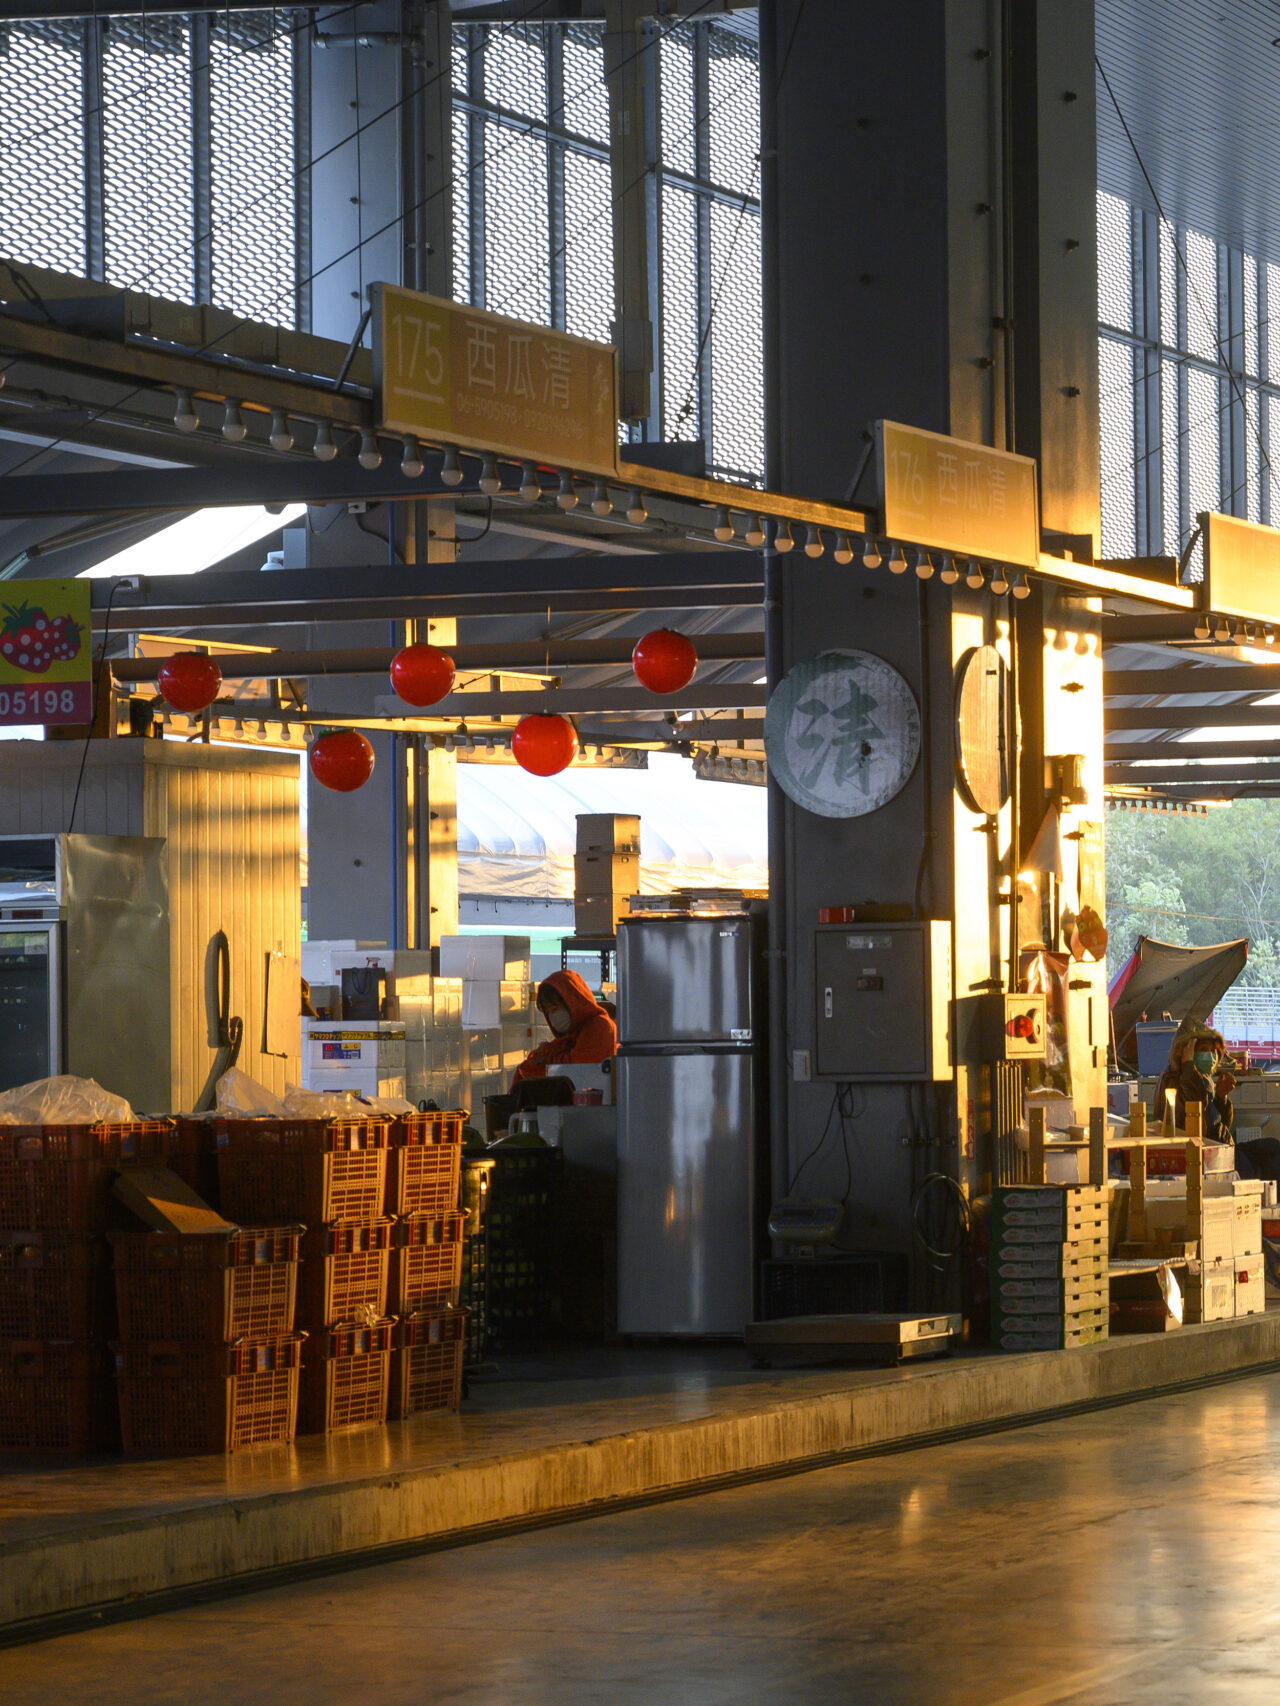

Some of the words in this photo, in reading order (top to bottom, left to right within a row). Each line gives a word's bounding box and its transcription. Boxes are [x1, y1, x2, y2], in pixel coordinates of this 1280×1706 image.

[391, 313, 444, 385] 175
[464, 320, 573, 410] 西瓜清
[890, 448, 925, 505] 176
[936, 451, 1008, 519] 西瓜清
[0, 689, 75, 715] 05198
